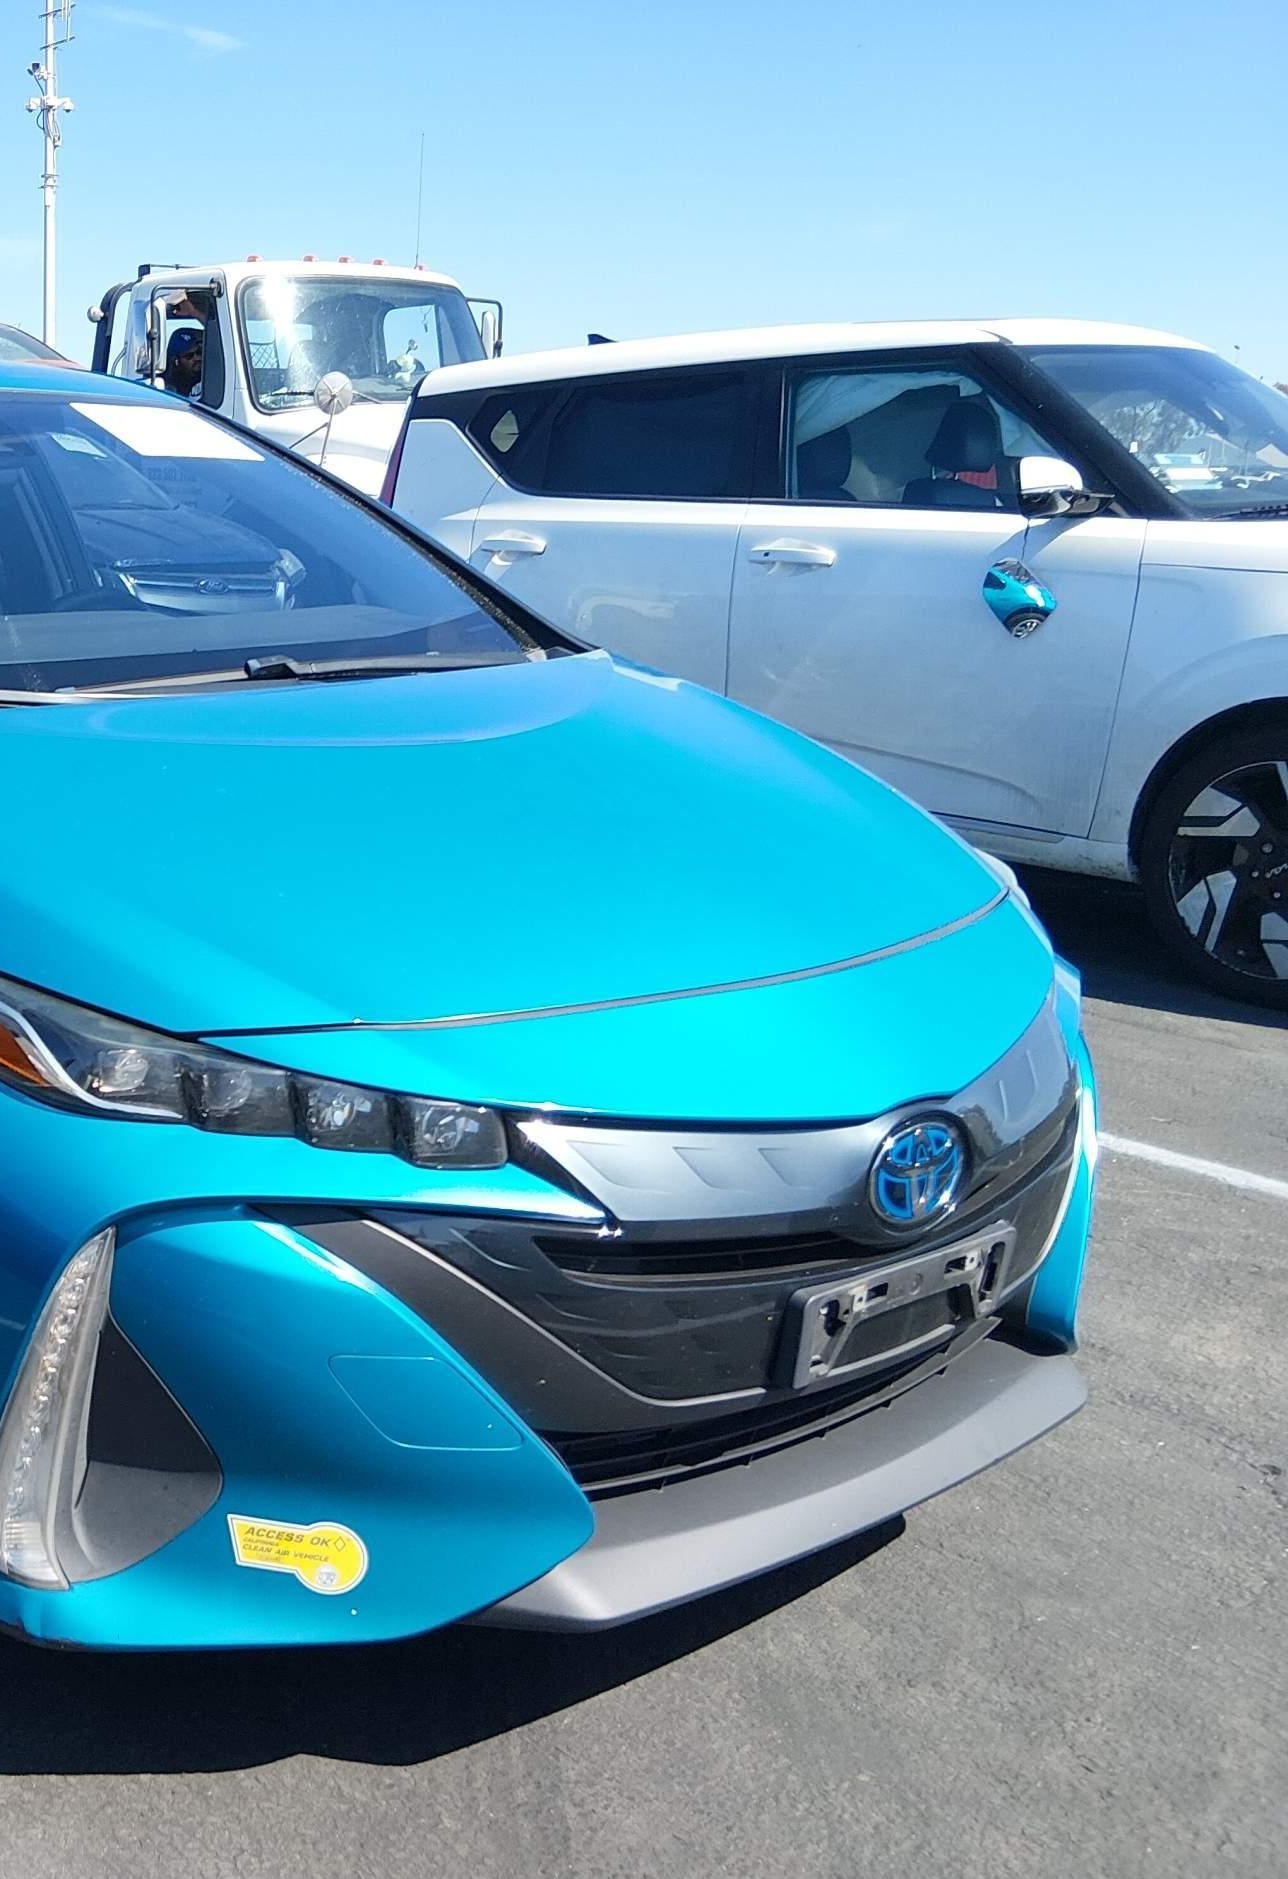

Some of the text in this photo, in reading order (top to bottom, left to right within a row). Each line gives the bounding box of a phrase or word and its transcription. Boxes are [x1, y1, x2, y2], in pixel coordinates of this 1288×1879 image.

[245, 1526, 332, 1547] ACCESS OK
[242, 1544, 329, 1562] CLEAN AIR VEHICLE
